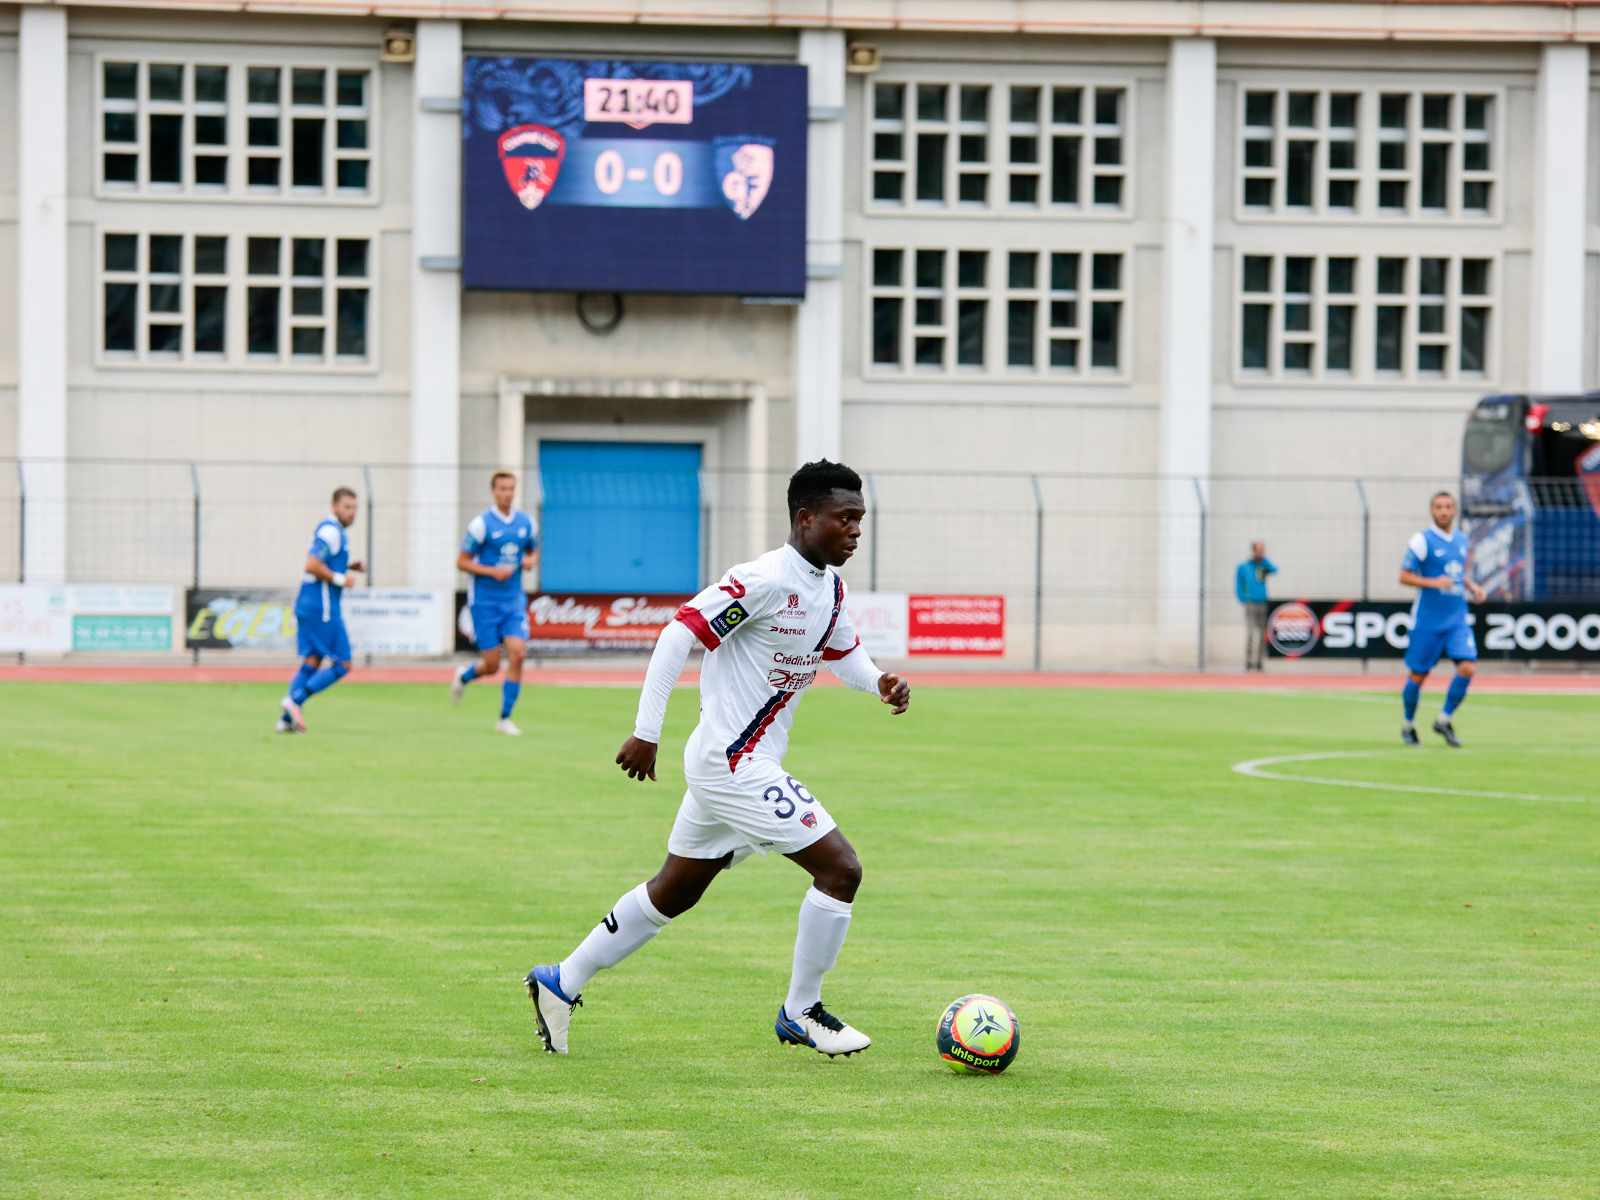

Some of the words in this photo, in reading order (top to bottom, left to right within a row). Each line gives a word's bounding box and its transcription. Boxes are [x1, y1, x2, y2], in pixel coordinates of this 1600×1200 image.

[597, 86, 681, 115] 21:40
[779, 627, 806, 636] PATRICK
[1485, 613, 1600, 652] 2000
[773, 652, 804, 667] Crédit
[762, 775, 815, 819] 36
[951, 1045, 1000, 1068] uhlsport
